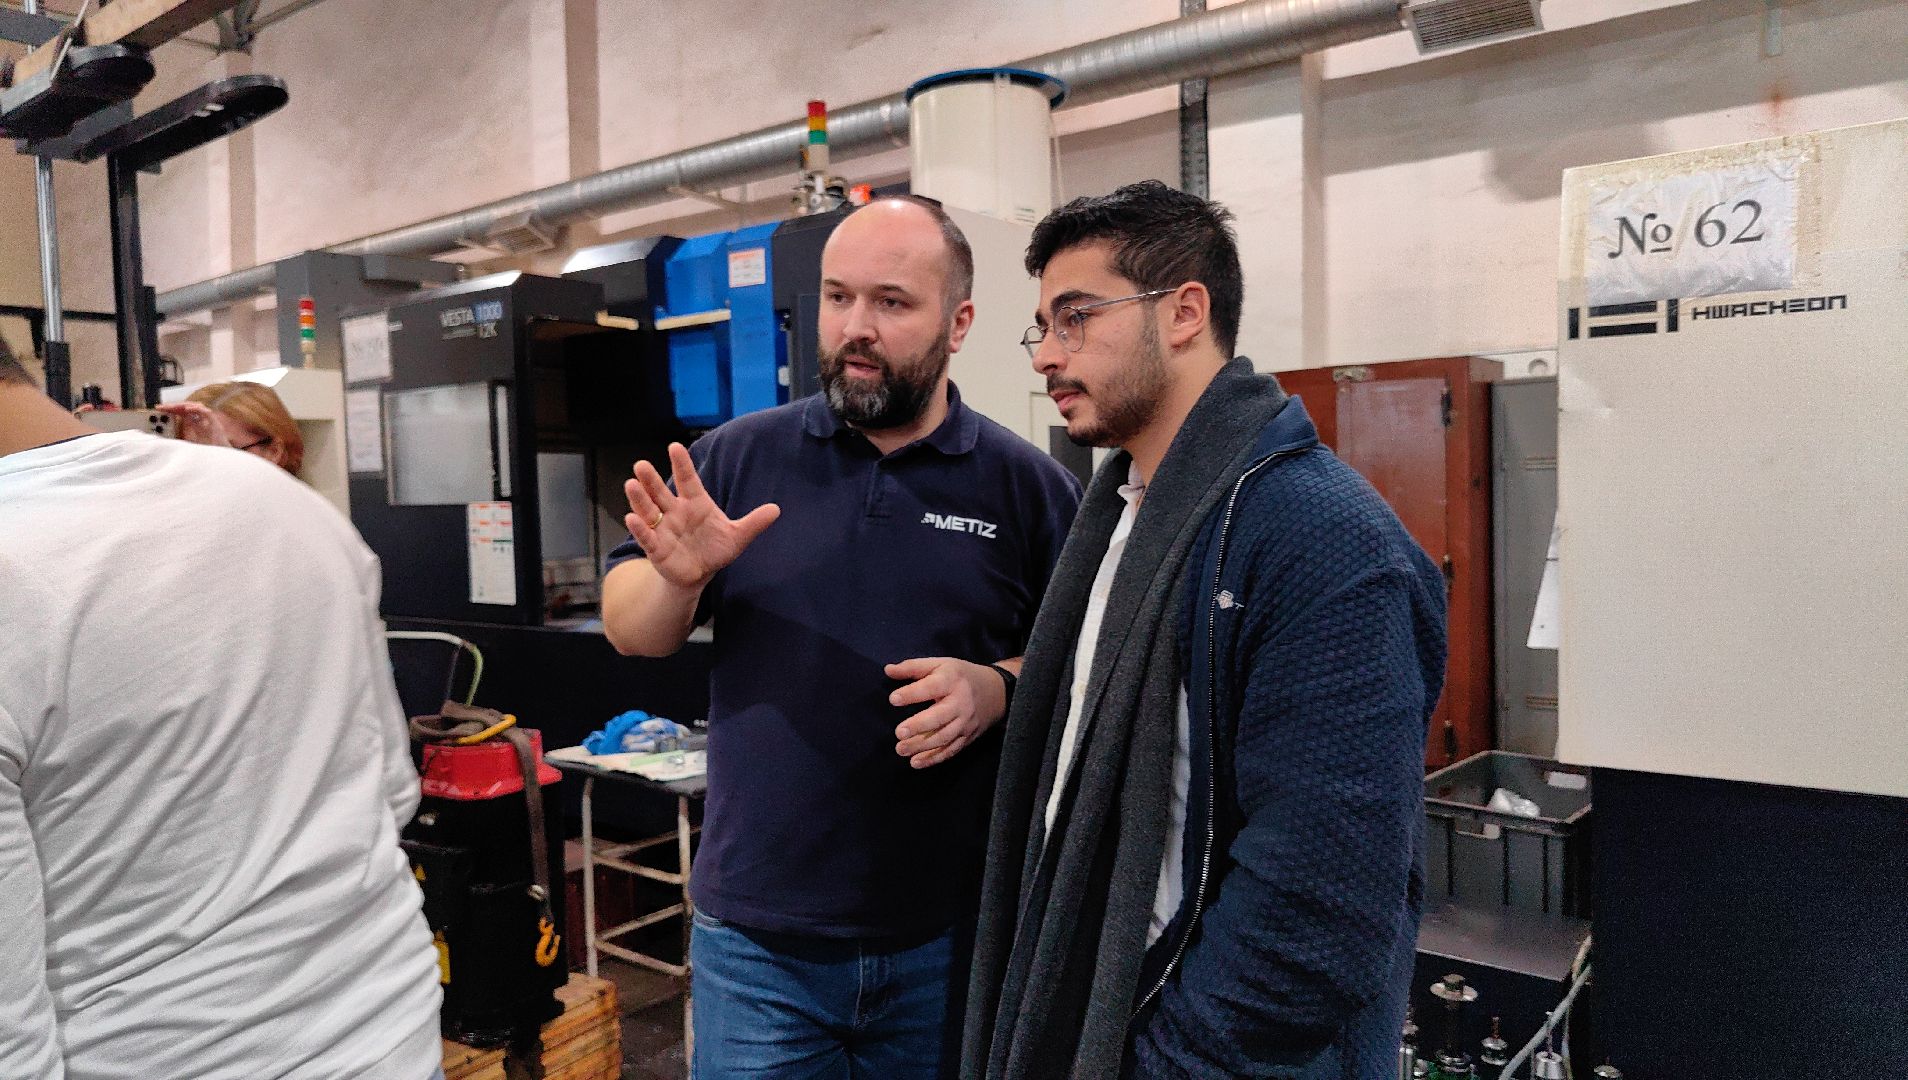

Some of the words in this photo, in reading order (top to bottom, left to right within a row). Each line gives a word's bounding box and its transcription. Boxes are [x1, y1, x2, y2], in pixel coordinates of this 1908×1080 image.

[1693, 198, 1765, 248] 62
[440, 307, 475, 327] VESTA
[1691, 294, 1849, 321] HWACHEON
[934, 514, 998, 540] METIZ
